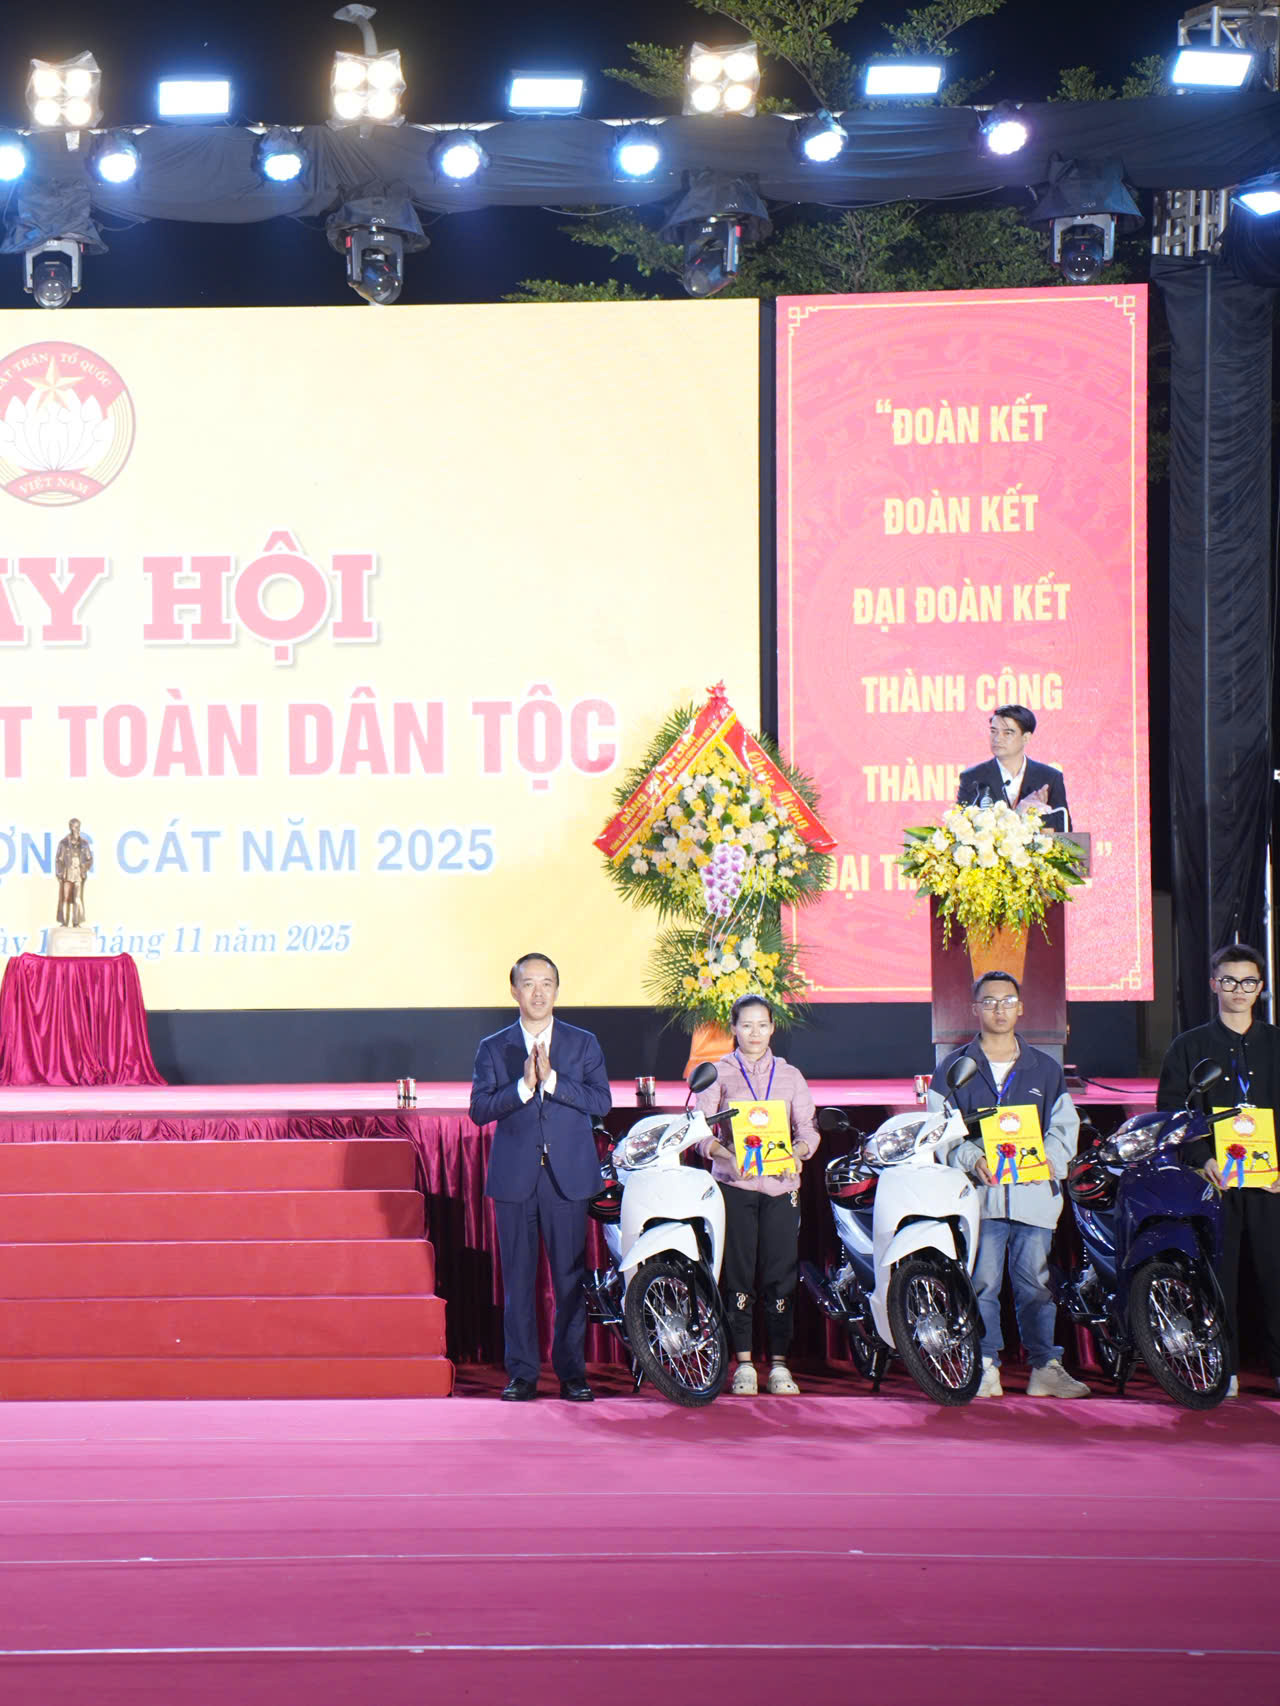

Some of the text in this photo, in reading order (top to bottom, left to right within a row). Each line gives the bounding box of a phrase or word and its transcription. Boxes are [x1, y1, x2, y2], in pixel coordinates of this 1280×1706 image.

[990, 393, 1047, 443] KẾT
[57, 476, 89, 495] NAM
[883, 483, 1038, 536] ĐOÀN KẾT
[143, 530, 375, 662] HỘI
[852, 571, 1071, 633] ĐẠI ĐOÀN KẾT
[861, 665, 1063, 714] THÀNH CÔNG
[58, 687, 258, 778] TOÀN
[288, 686, 444, 775] DÂN
[471, 684, 617, 791] TỘC
[116, 818, 222, 875] CÁT
[242, 817, 356, 873] NĂM
[377, 829, 494, 872] 2025
[175, 927, 201, 953] 11
[214, 927, 276, 953] năm
[285, 924, 353, 953] 2025
